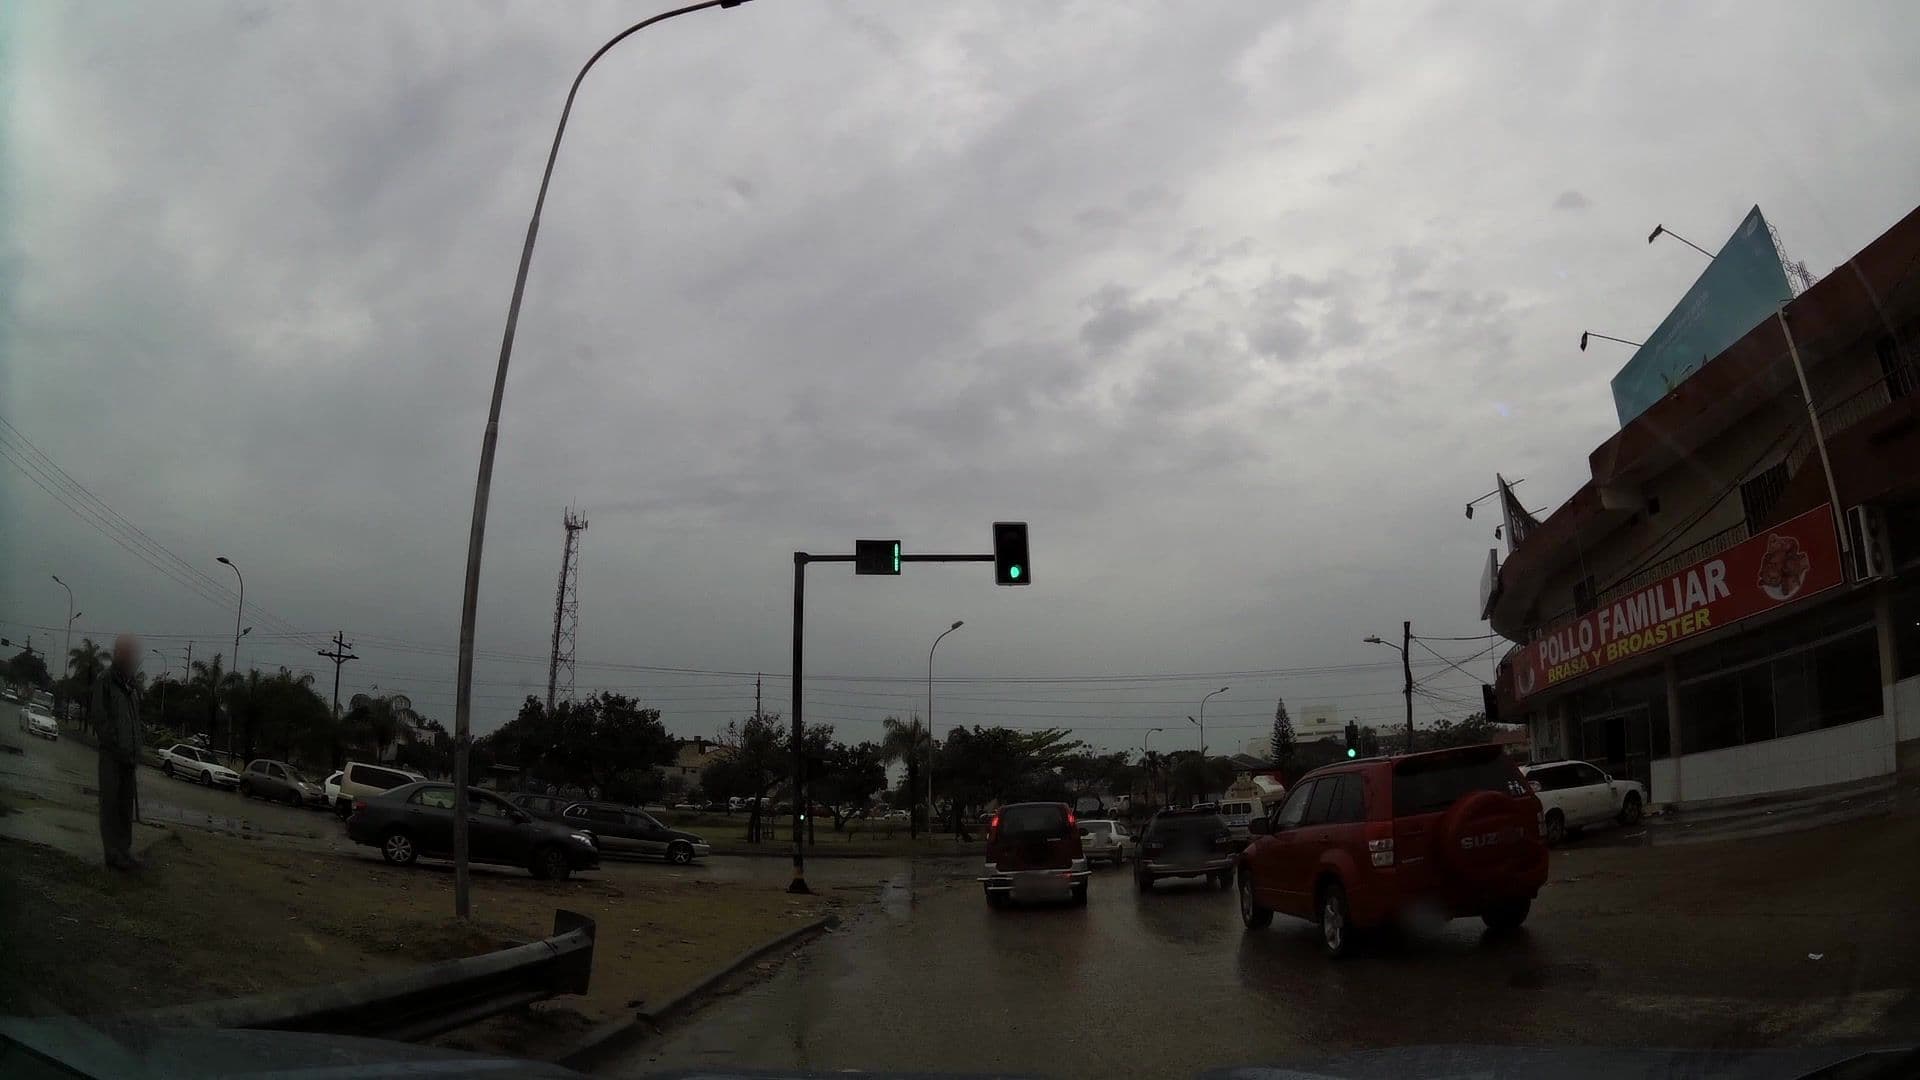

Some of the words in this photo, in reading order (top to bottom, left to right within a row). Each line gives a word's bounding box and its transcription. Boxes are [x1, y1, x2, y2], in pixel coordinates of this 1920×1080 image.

[1537, 619, 1593, 671] POLLO
[1597, 558, 1731, 646] FAMILIAR
[1548, 657, 1590, 685] BRASA
[1591, 650, 1602, 668] Y
[1606, 607, 1712, 663] BROASTER
